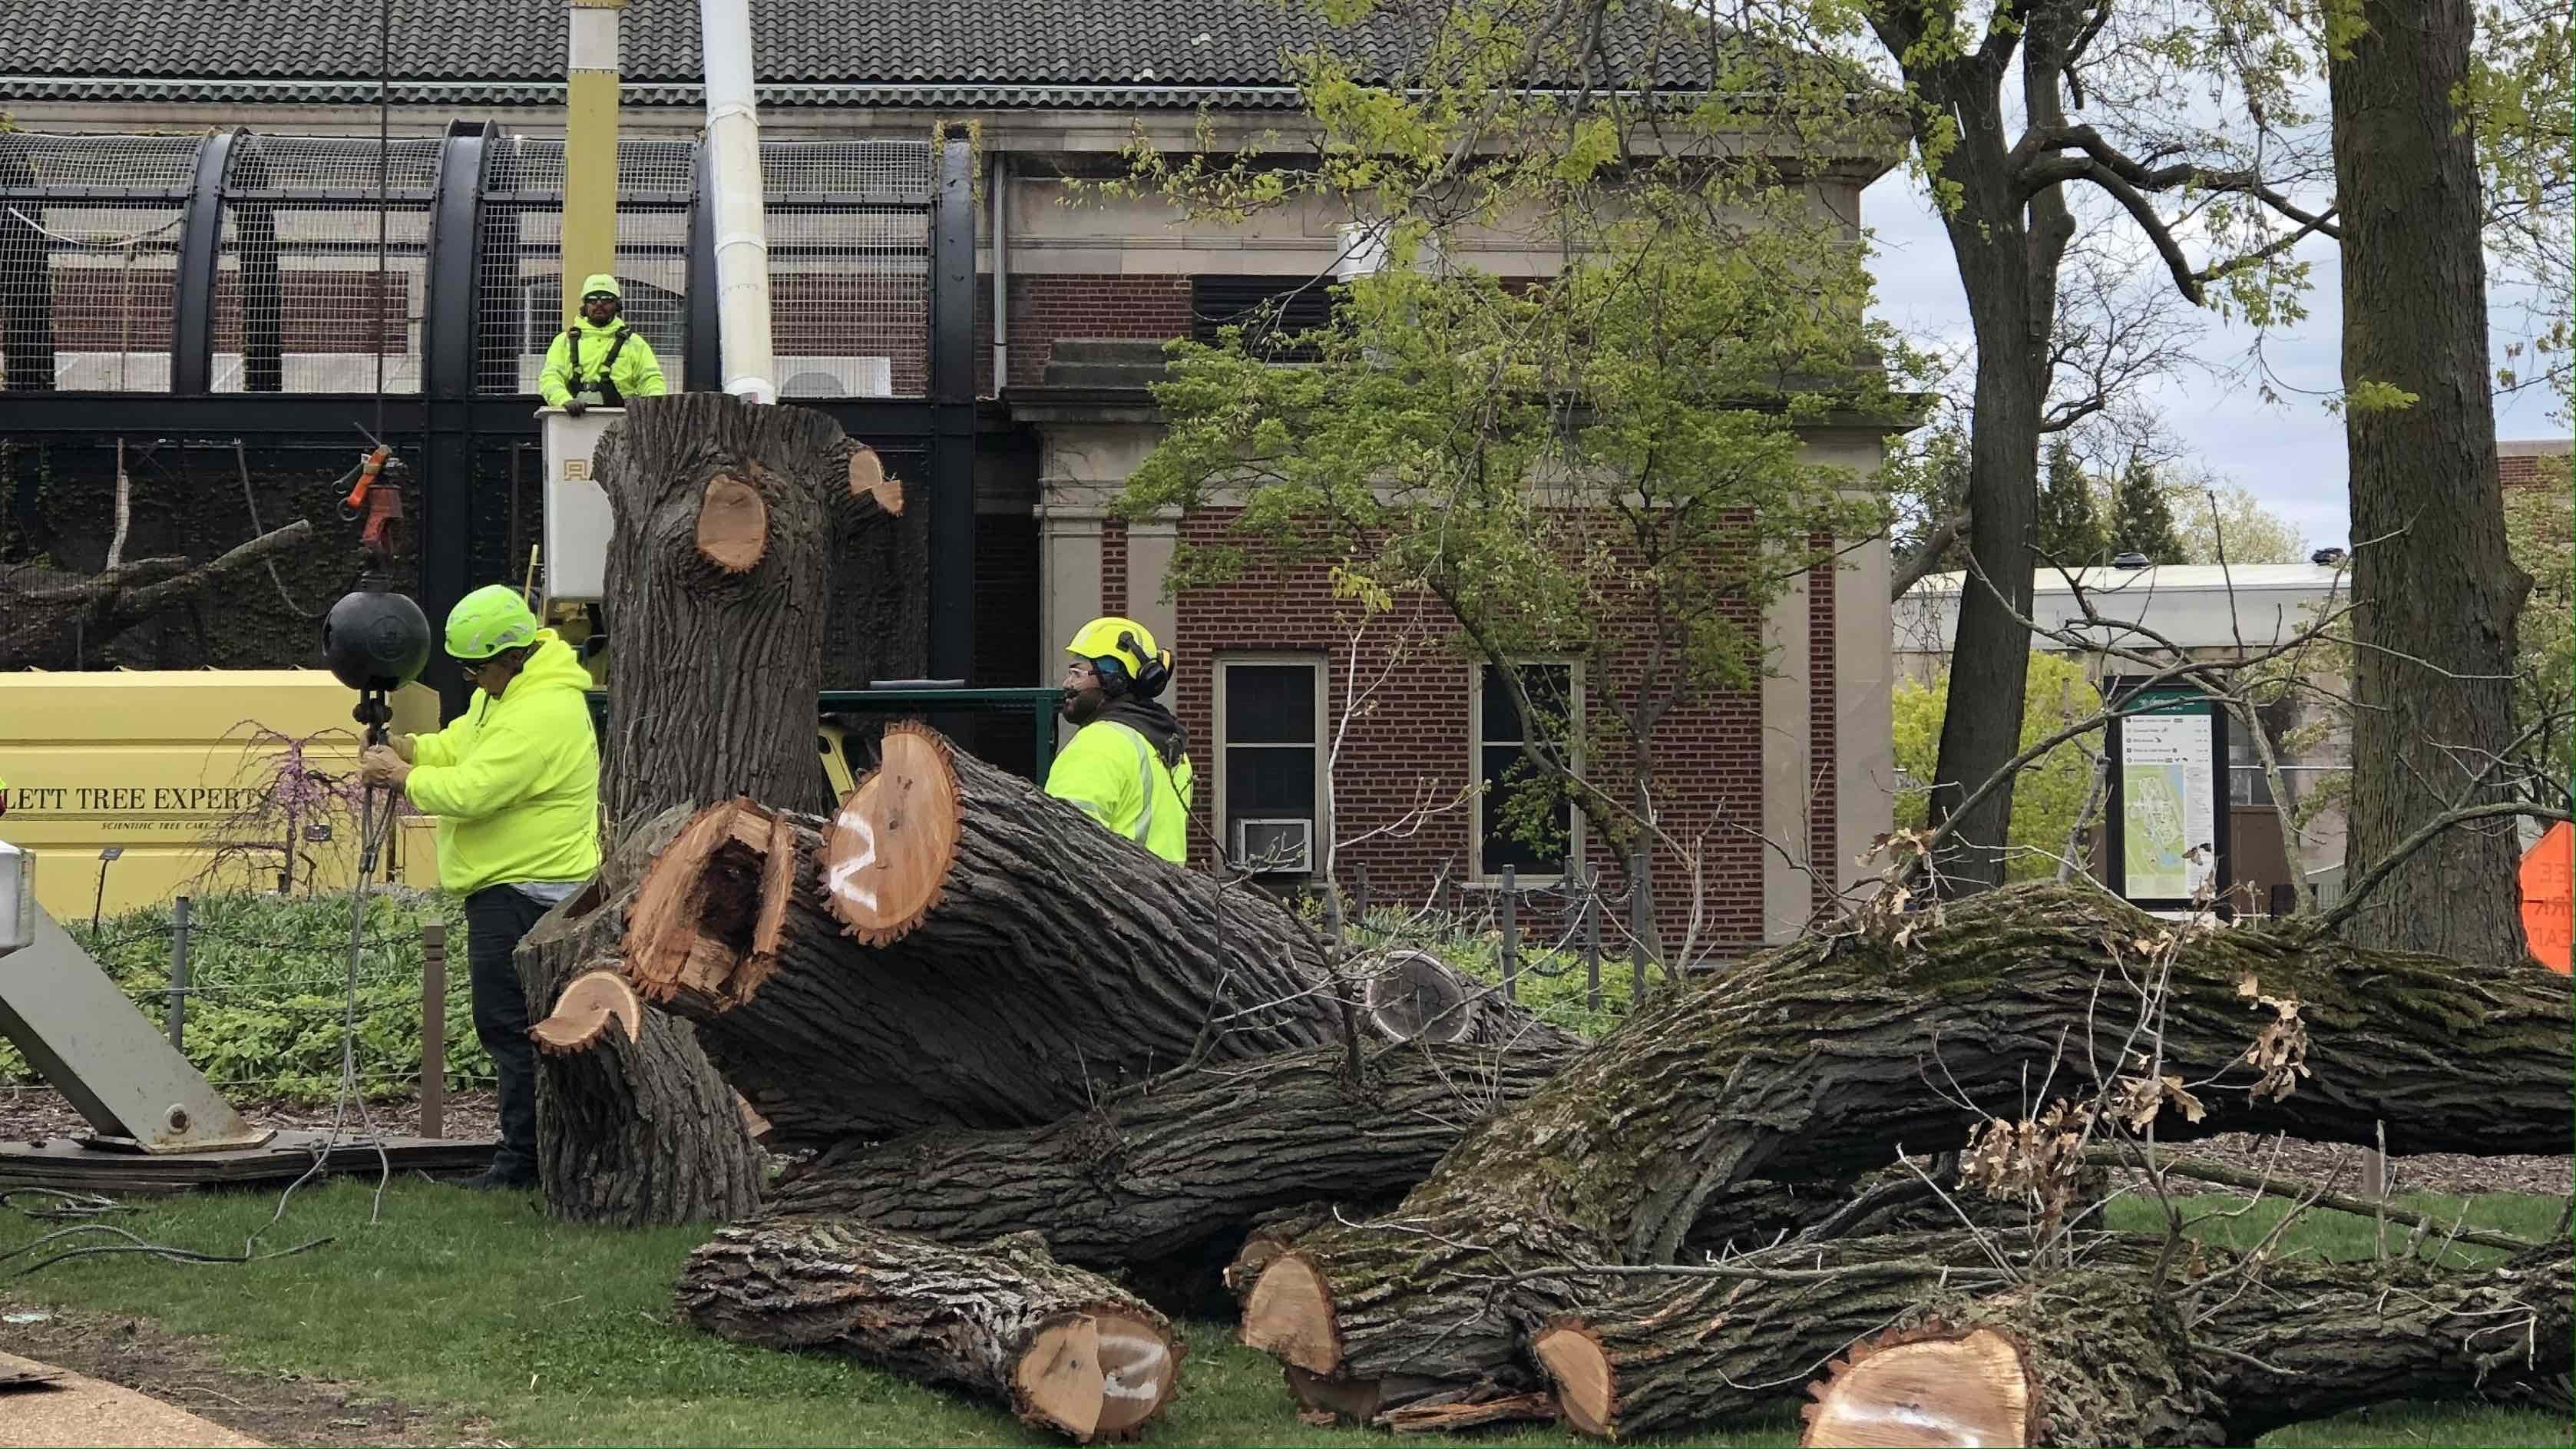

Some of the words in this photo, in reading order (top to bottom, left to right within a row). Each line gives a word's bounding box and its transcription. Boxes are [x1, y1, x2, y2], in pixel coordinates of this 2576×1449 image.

[2, 788, 67, 809] LETT
[75, 788, 146, 809] TREE
[828, 810, 878, 911] 2
